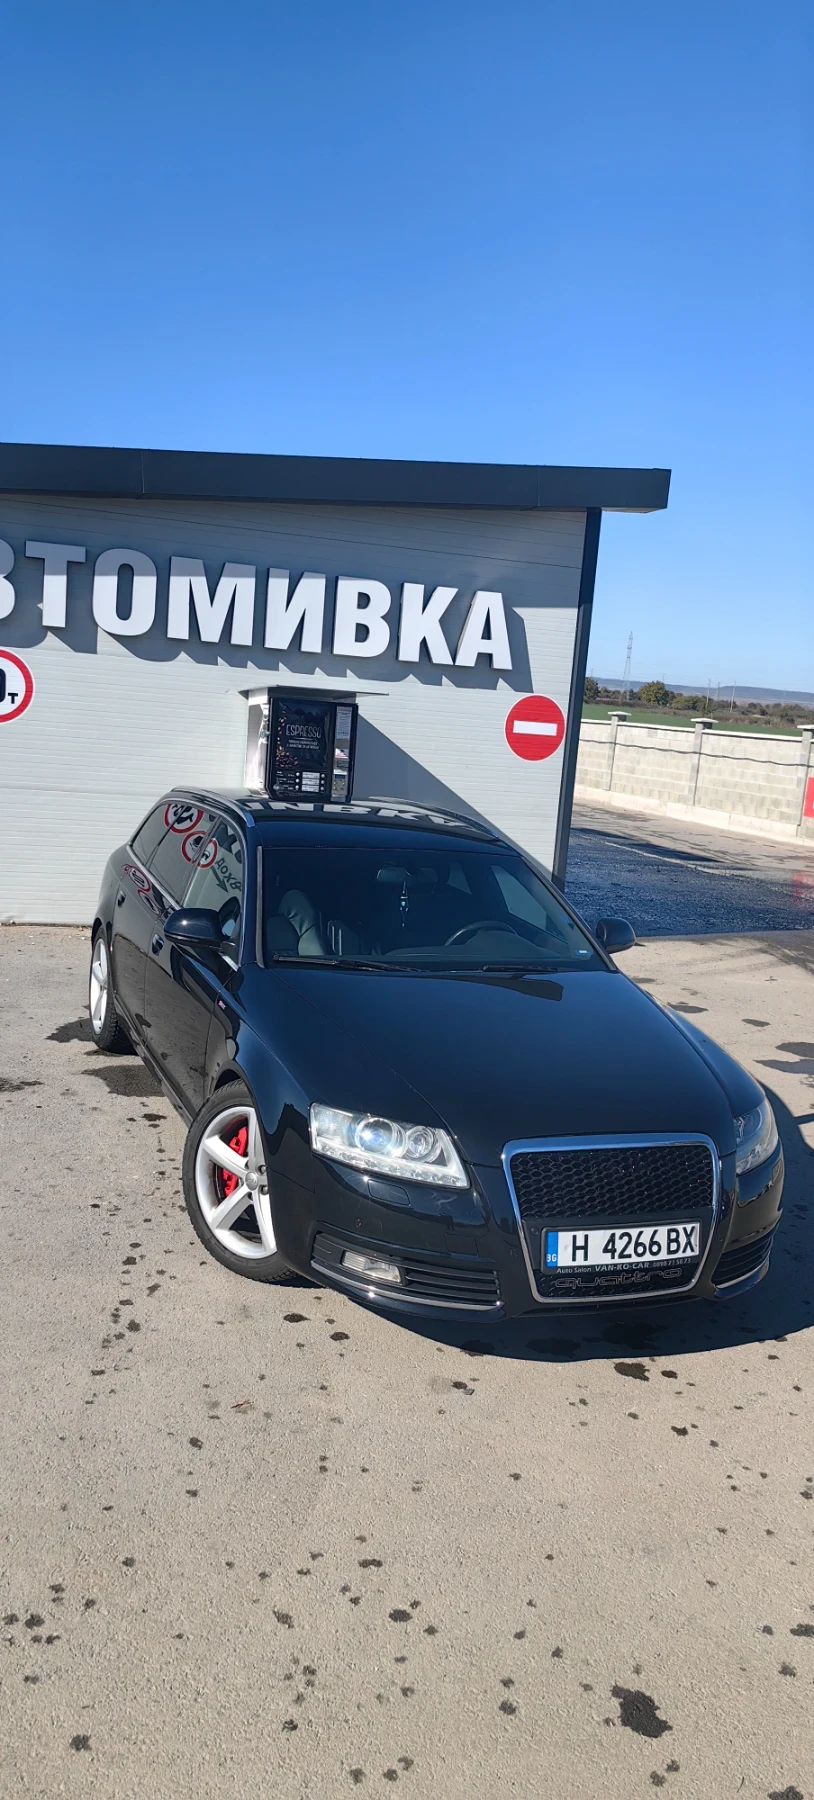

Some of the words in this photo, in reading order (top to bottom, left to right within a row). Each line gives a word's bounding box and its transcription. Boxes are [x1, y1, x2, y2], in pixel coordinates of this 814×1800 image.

[0, 538, 513, 670] ТОМИВКА
[286, 724, 322, 739] ESPRESSO
[571, 1234, 589, 1262] H
[602, 1229, 662, 1260] 4266
[666, 1225, 696, 1255] BX
[546, 1253, 557, 1263] BG
[595, 1262, 650, 1272] VAN-KO-CAR
[555, 1267, 683, 1290] quattro
